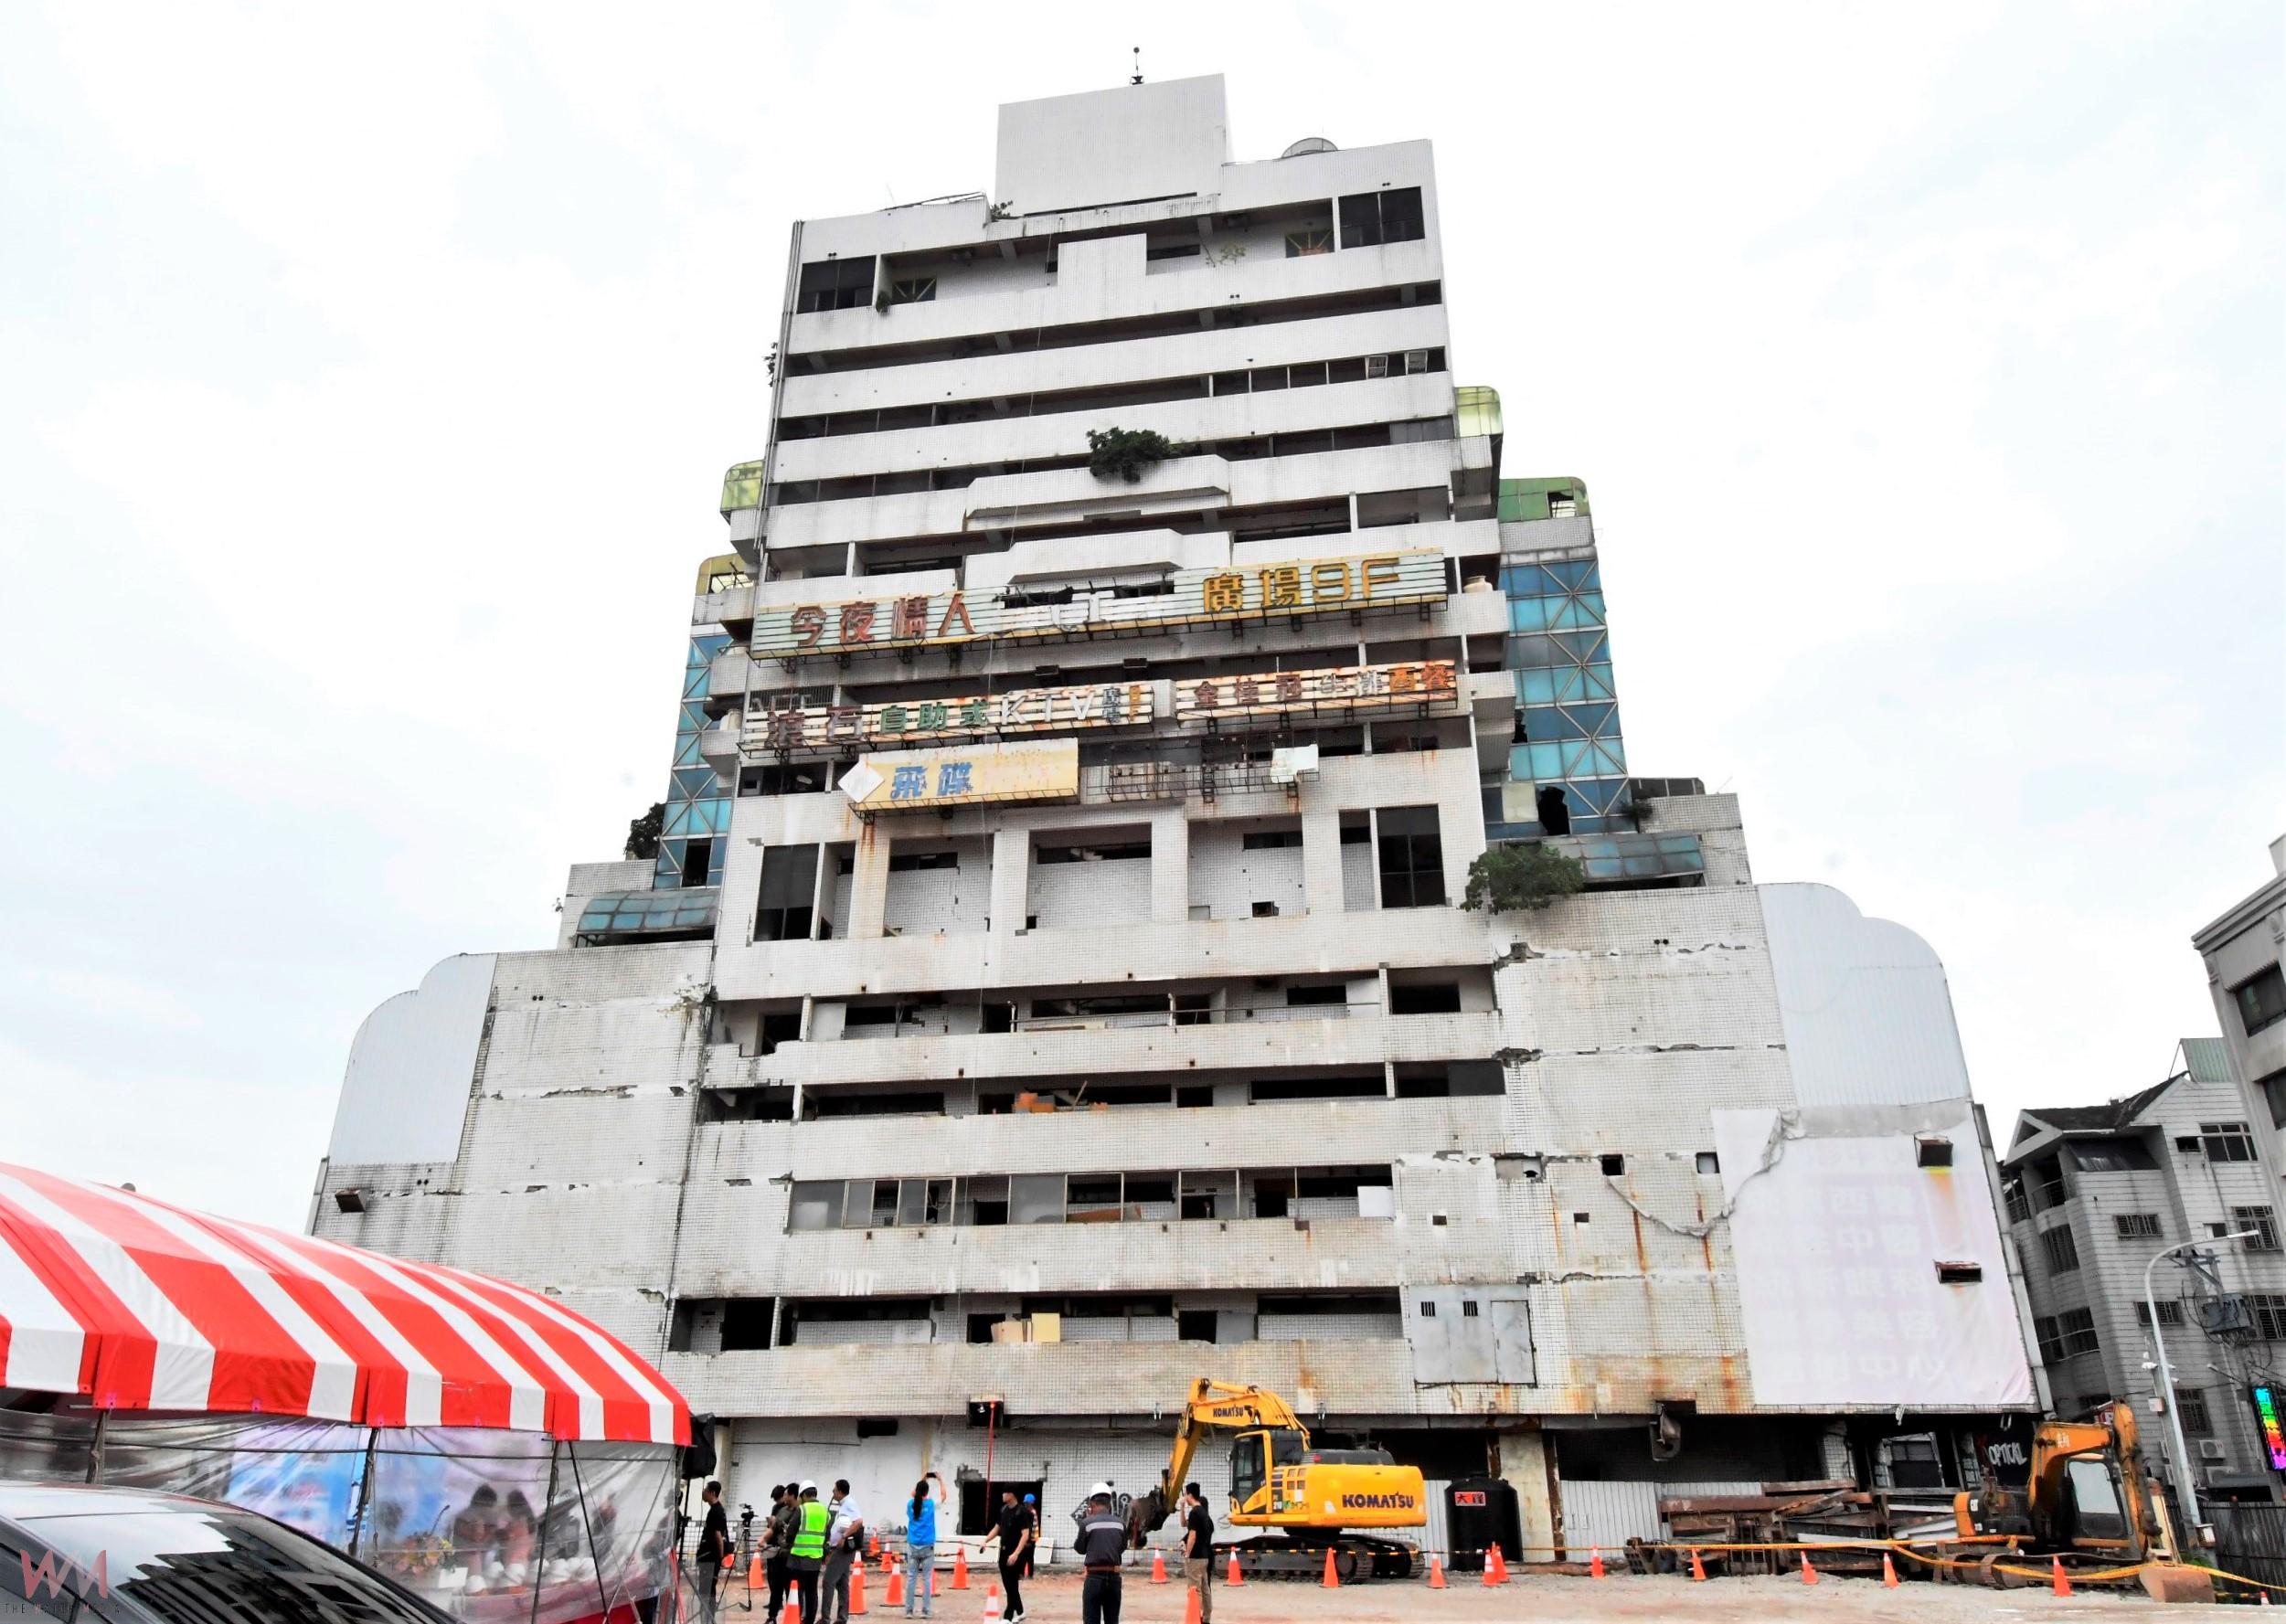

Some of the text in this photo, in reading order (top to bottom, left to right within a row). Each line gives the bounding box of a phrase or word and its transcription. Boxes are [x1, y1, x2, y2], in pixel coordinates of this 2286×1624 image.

[791, 593, 976, 645] 今夜情人
[1203, 557, 1399, 613] 廣場9F
[1212, 1406, 1244, 1417] KOMATSU
[1342, 1491, 1414, 1509] KOMATSU
